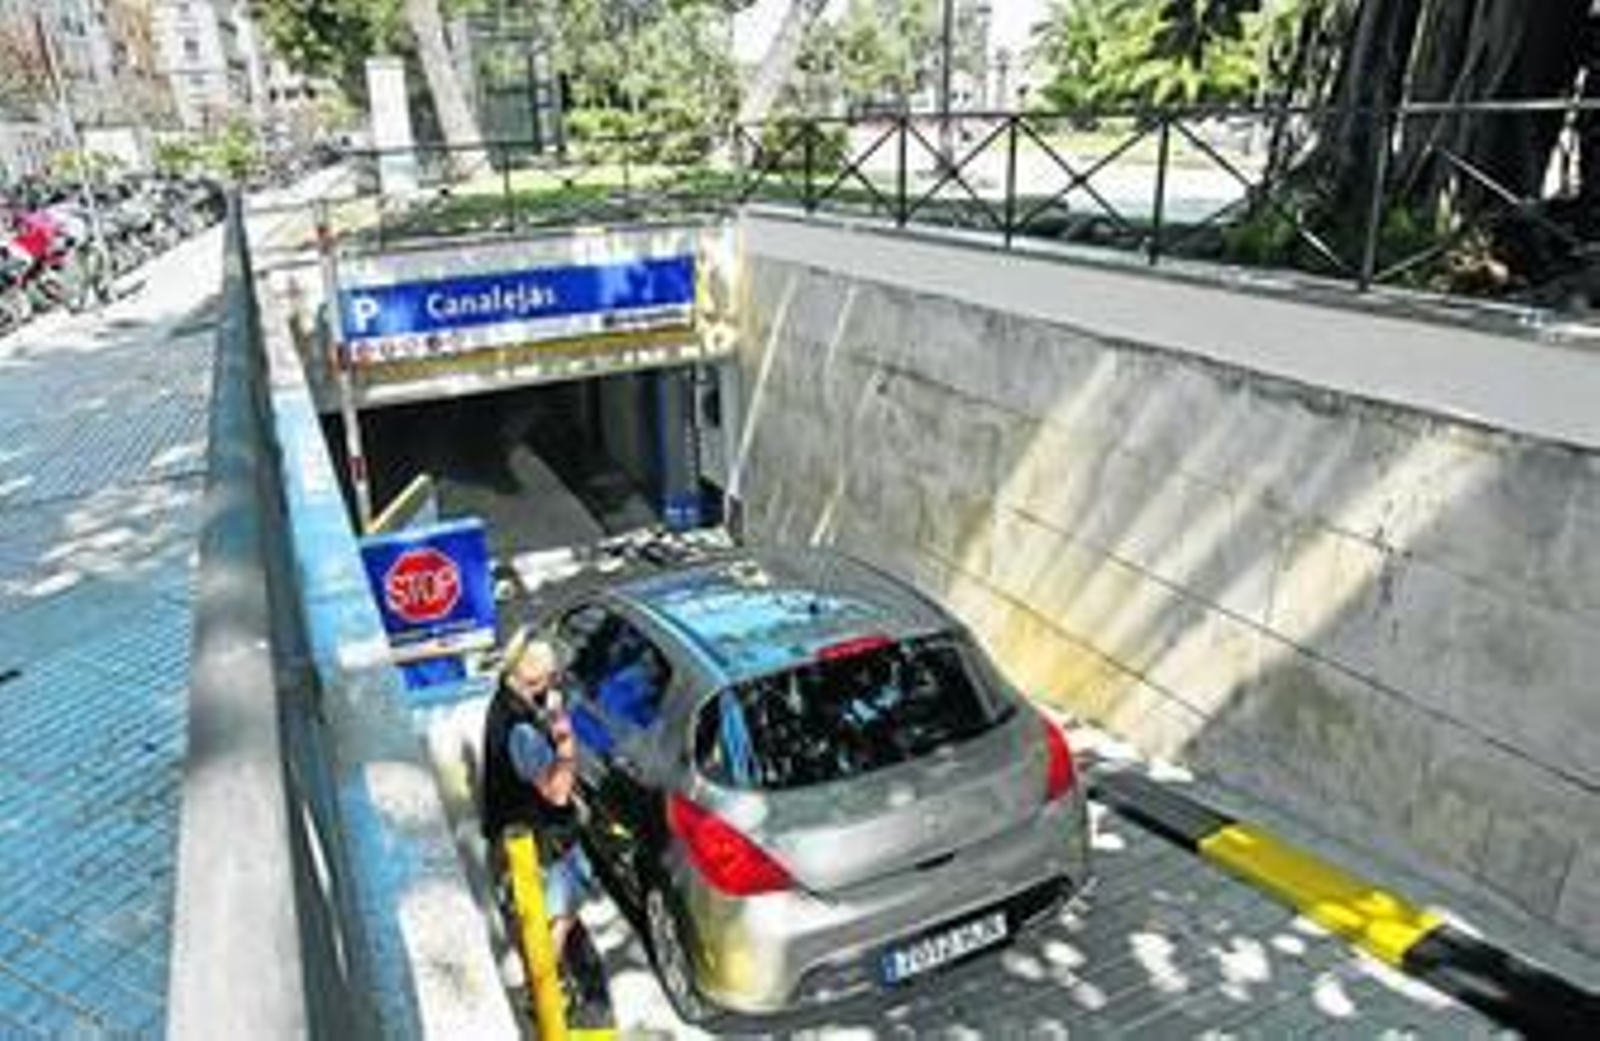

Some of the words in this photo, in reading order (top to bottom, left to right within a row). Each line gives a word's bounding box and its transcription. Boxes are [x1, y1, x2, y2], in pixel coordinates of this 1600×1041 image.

[354, 295, 379, 333] P
[426, 284, 555, 319] Canalejas
[391, 567, 455, 606] STOP
